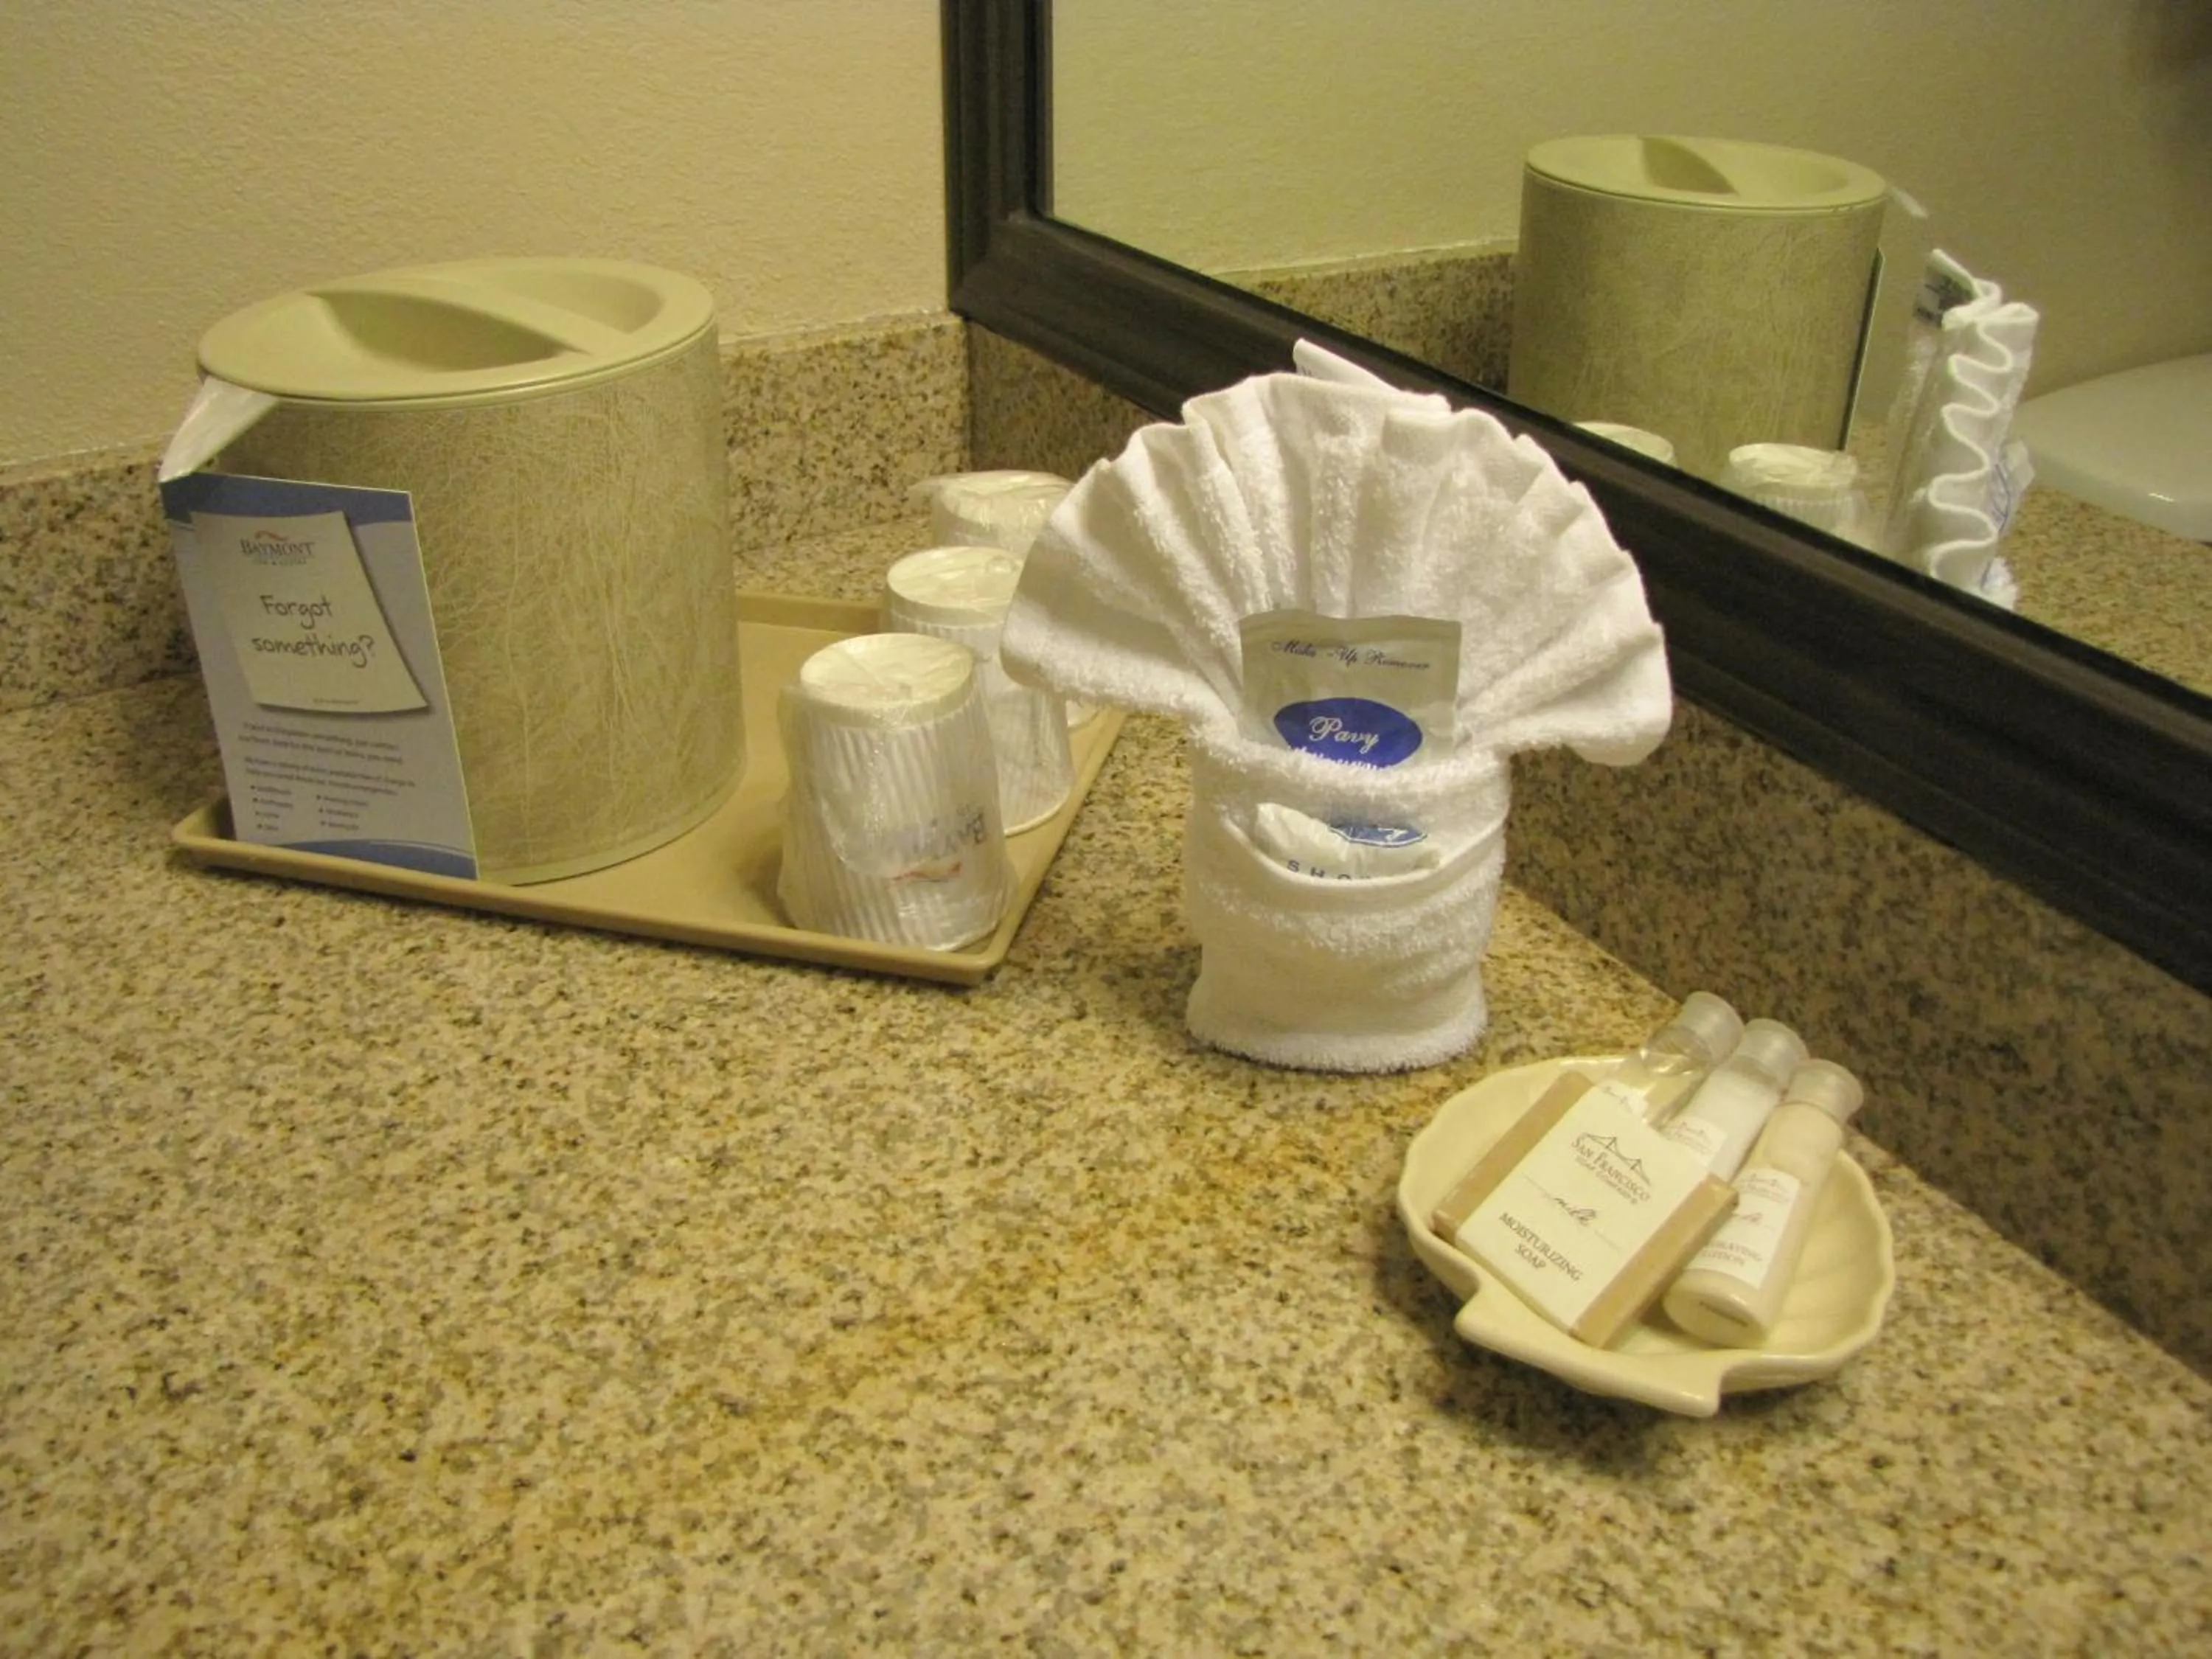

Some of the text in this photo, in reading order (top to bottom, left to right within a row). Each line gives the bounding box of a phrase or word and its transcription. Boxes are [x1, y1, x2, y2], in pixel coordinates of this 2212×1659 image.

[240, 539, 315, 556] BAYMONT
[260, 594, 333, 630] Forgot
[251, 633, 375, 668] something?
[1271, 640, 1317, 658] Make
[1309, 717, 1380, 754] Pavy
[1499, 1212, 1584, 1281] MOISTURIZING
[1514, 1243, 1547, 1269] SOAP
